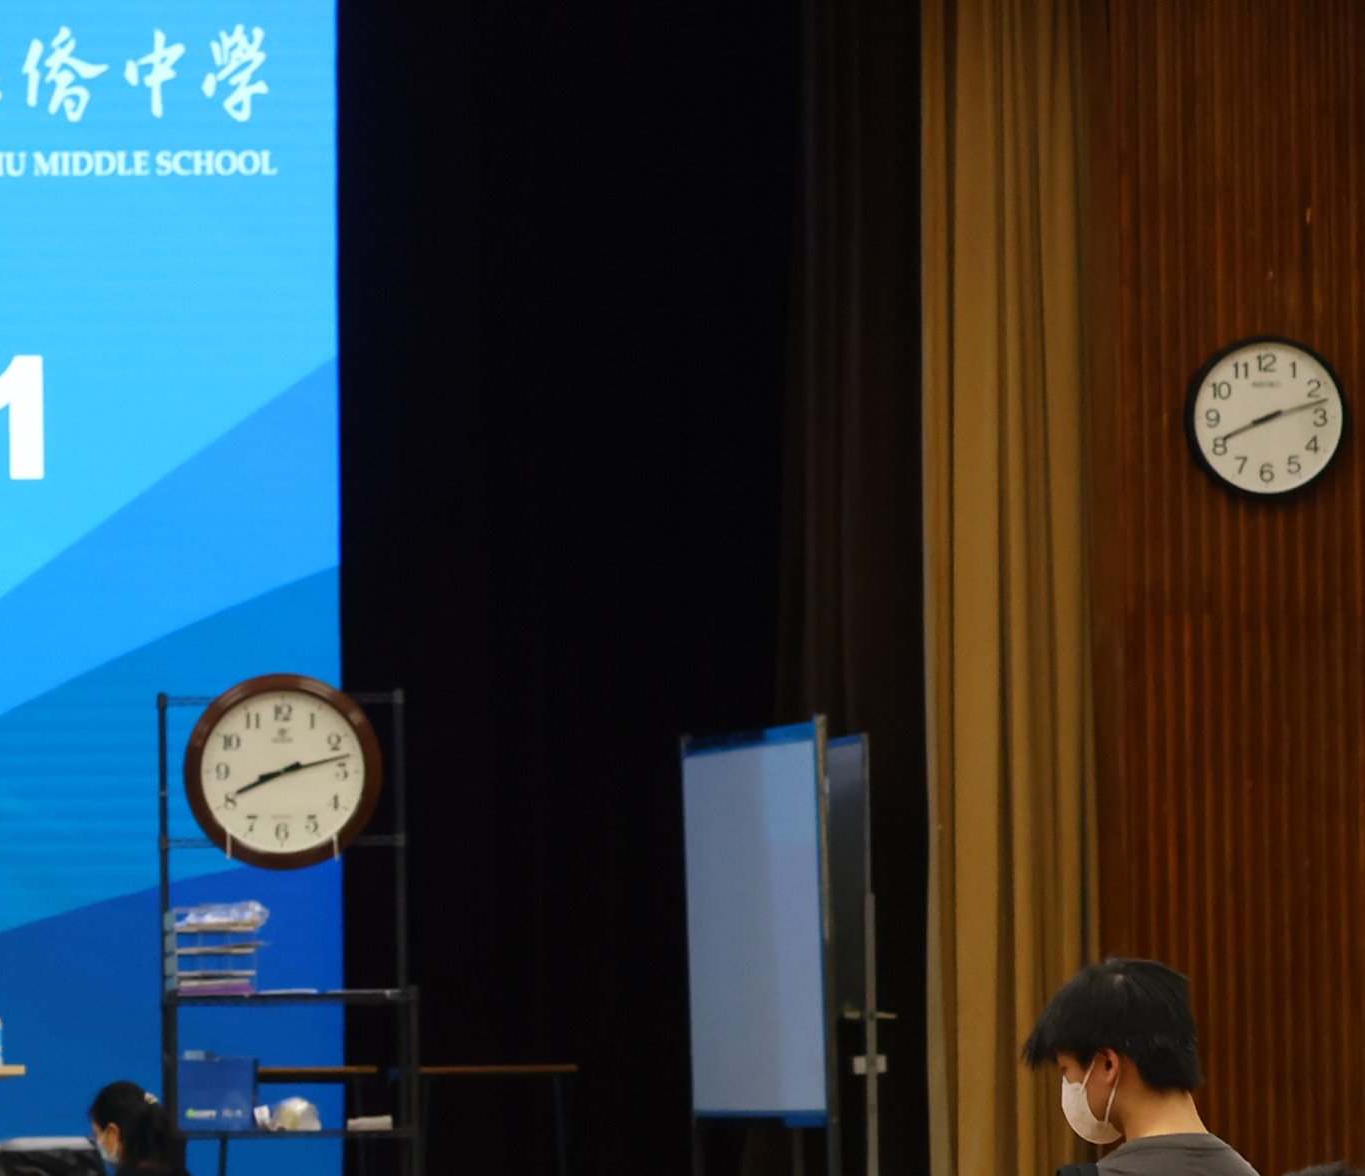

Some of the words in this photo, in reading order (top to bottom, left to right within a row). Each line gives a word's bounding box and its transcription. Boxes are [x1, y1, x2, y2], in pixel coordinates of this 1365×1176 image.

[33, 151, 151, 178] MIDDLE
[156, 151, 279, 177] SCHOOL
[1233, 361, 1249, 379] 11
[1256, 353, 1276, 372] 12
[1290, 361, 1297, 379] 1
[1211, 381, 1231, 400] 10
[1307, 379, 1322, 398] 2
[1205, 409, 1220, 428] 9
[1312, 408, 1328, 427] 3
[1212, 437, 1227, 456] 8
[1305, 435, 1320, 454] 4
[1235, 456, 1248, 474] 7
[1259, 463, 1274, 483] 6
[1288, 455, 1301, 474] 5
[244, 711, 260, 729] 11
[274, 703, 293, 722] 12
[309, 712, 315, 729] 1
[222, 734, 241, 750] 10
[327, 734, 342, 751] 2
[216, 763, 230, 780] 9
[335, 762, 348, 780] 3
[224, 793, 237, 811] 8
[329, 794, 340, 811] 4
[246, 815, 258, 833] 7
[275, 823, 289, 840] 6
[305, 814, 319, 833] 5
